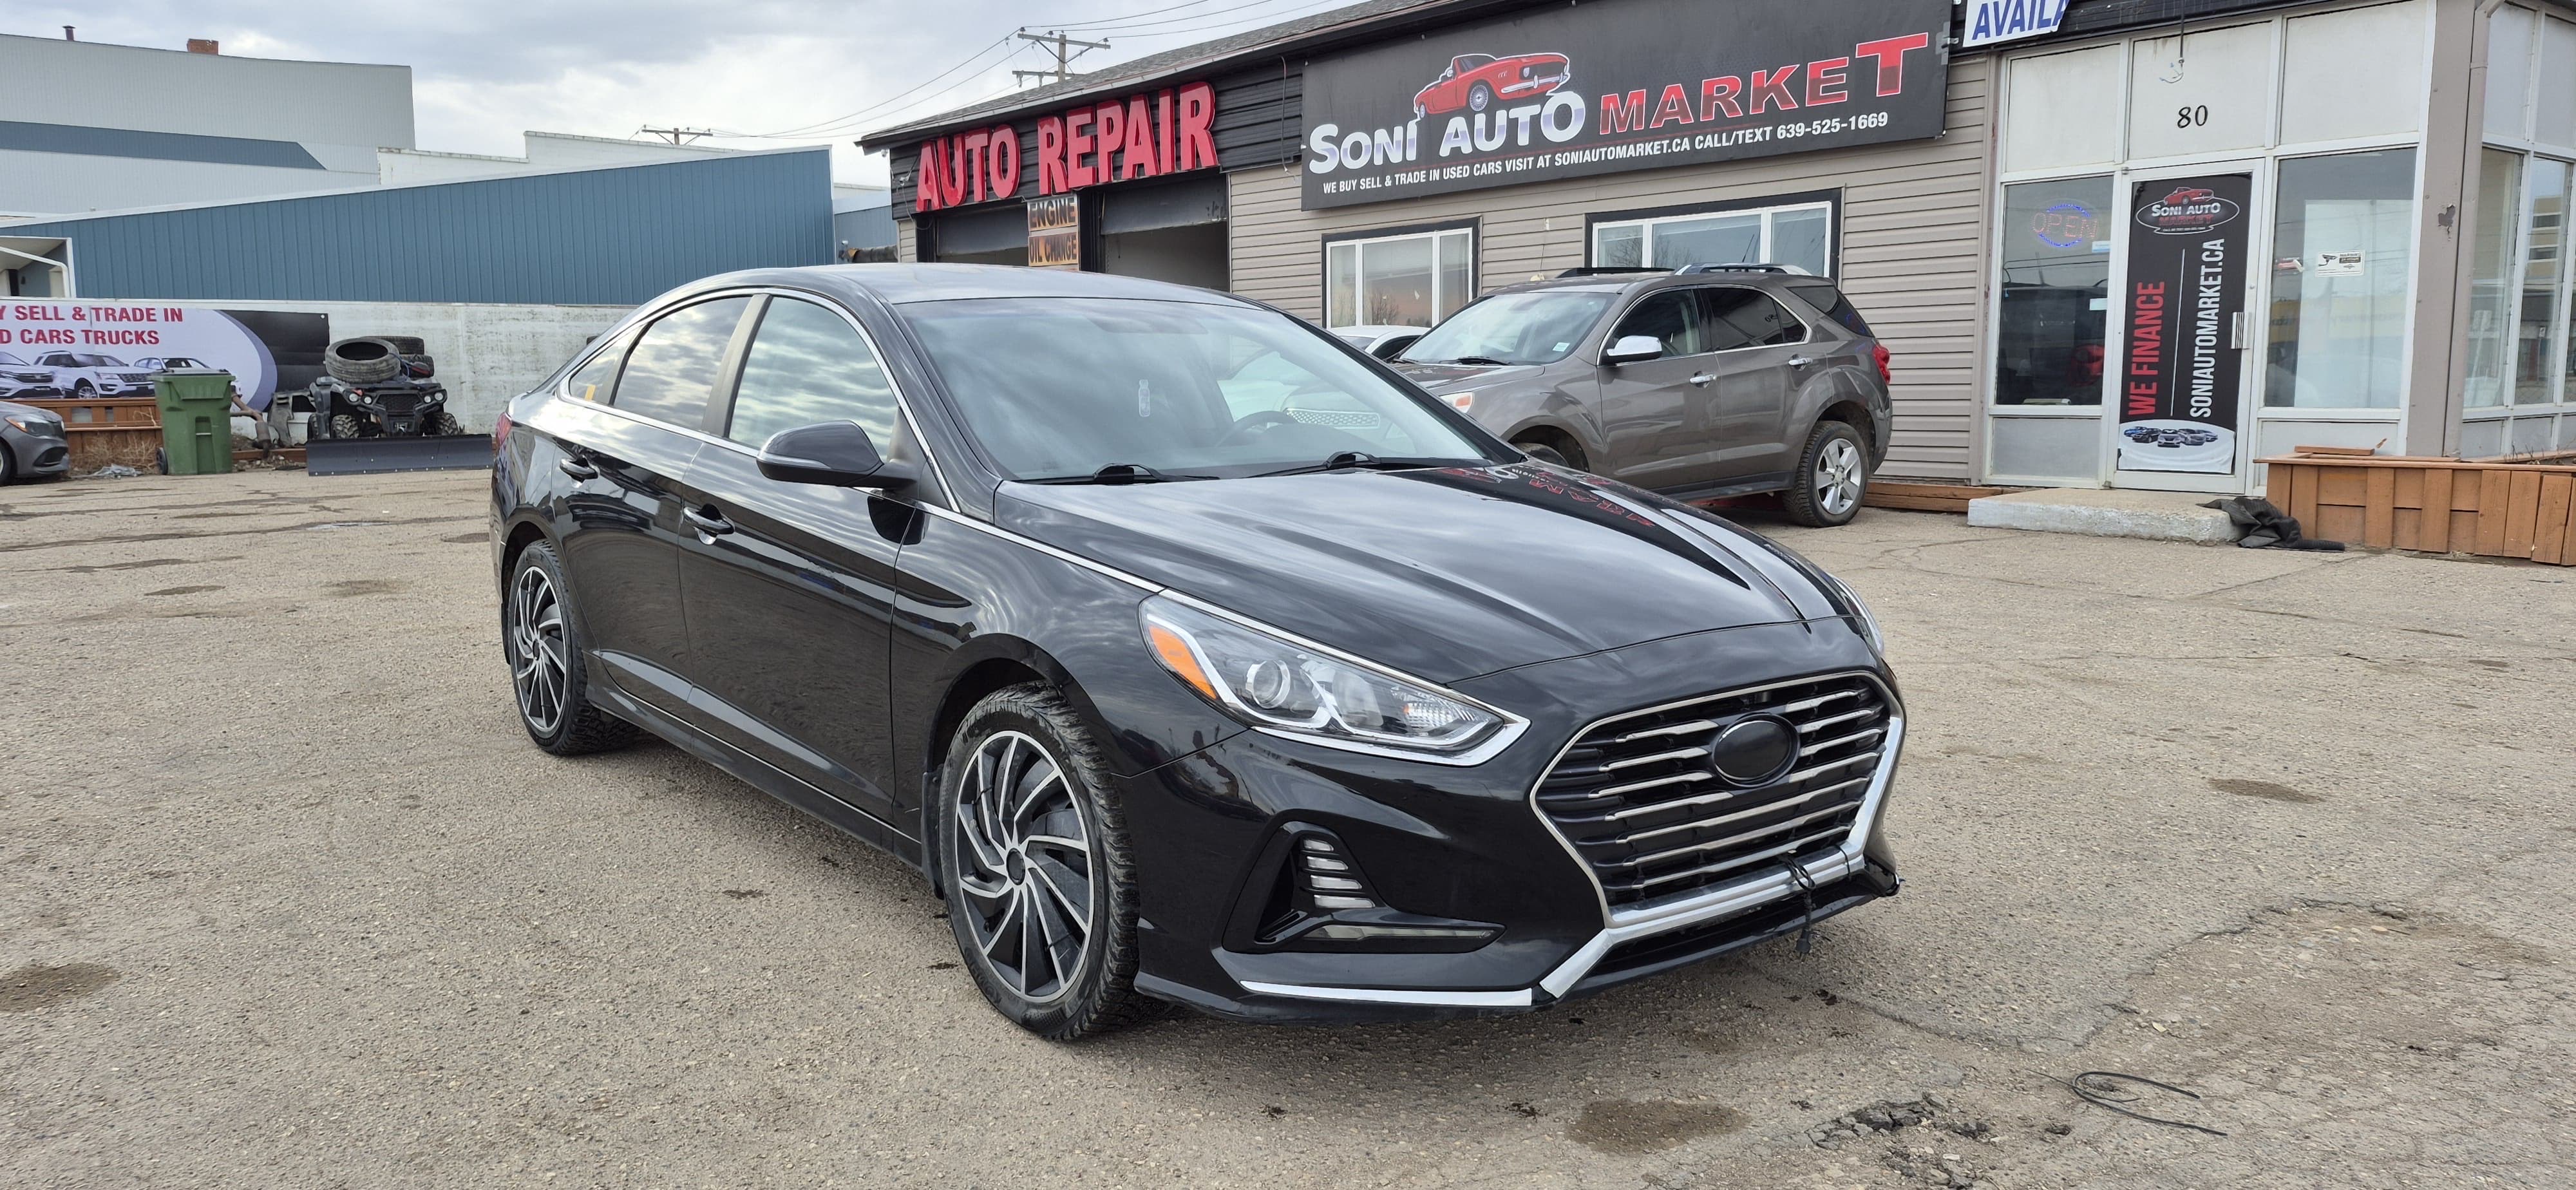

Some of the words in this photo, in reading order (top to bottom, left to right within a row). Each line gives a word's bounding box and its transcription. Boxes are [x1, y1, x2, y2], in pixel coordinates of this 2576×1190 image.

[1439, 91, 1586, 157] AUTO
[1599, 32, 1929, 135] MARKET
[2177, 105, 2208, 129] 80
[915, 124, 1020, 212] AUTO
[1037, 81, 1219, 194] REPAIR
[1323, 181, 1337, 194] WE
[1340, 179, 1358, 192] BUY
[1359, 176, 1382, 189] SELL
[1385, 175, 1392, 187] &
[1394, 170, 1426, 185] TRADE
[1429, 169, 1440, 181] IN
[1443, 165, 1470, 180] USED
[1473, 161, 1502, 176] CARS
[1505, 156, 1534, 173] VISIT
[1537, 155, 1551, 169] AT
[1555, 136, 1690, 166] SONIAUTOMARKET.CA
[1694, 126, 1773, 151] CALL/TEXT
[1777, 111, 1889, 139] 639-525-1669
[1029, 197, 1076, 228] ENGINE
[2159, 214, 2215, 226] MARKET
[2186, 202, 2221, 214] AUTO
[2032, 212, 2098, 238] OPEN
[1029, 237, 1043, 263] OIL
[1045, 234, 1077, 262] CHANGE
[15, 305, 65, 321] SELL
[71, 307, 86, 321] &
[91, 307, 157, 322] TRADE
[164, 308, 184, 322] IN
[2131, 281, 2165, 375] FINANCE
[2190, 238, 2225, 418] SONIAUTOMARKET.CA
[20, 329, 75, 344] CARS
[81, 329, 160, 345] TRUCKS
[2128, 381, 2157, 415] WE
